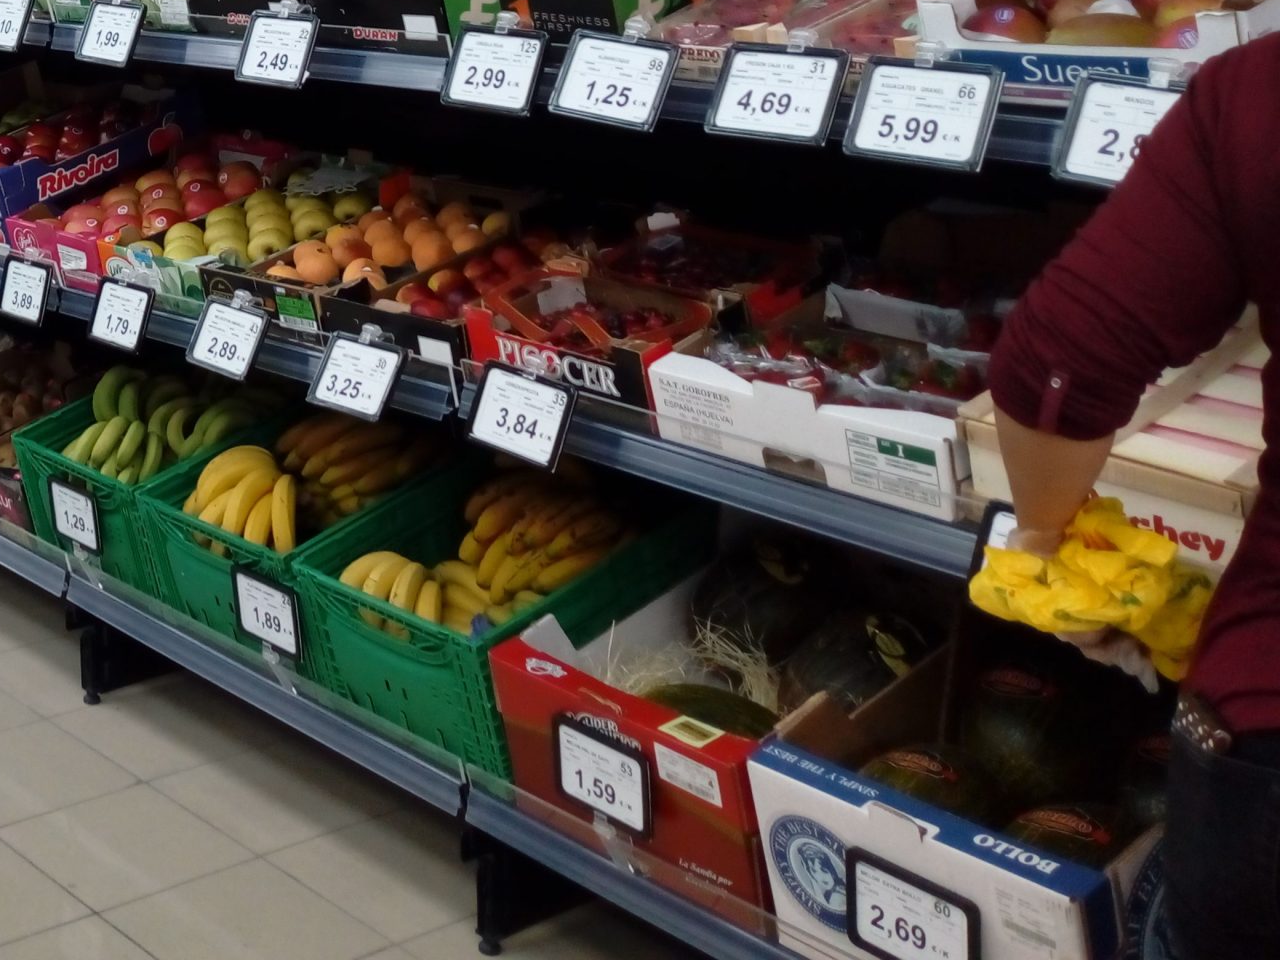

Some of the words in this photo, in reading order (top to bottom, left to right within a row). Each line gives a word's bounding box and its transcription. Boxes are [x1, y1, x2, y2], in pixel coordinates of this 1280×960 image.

[534, 11, 611, 27] FRESHNESS
[536, 21, 573, 33] FIRST
[96, 29, 120, 48] 1,99
[298, 29, 309, 40] 22
[520, 40, 538, 54] 125
[257, 50, 289, 72] 2,49
[648, 59, 664, 72] 98
[809, 61, 826, 74] 31
[464, 66, 506, 89] 2,99
[586, 80, 632, 108] 1,25
[737, 89, 793, 116] 4,69
[958, 86, 976, 100] 66
[878, 114, 939, 144] 5,99
[38, 149, 119, 201] Rivoira
[12, 292, 33, 309] 3,89
[106, 314, 129, 335] 1,79
[207, 337, 237, 361] 2,89
[326, 374, 362, 398] 3,25
[552, 393, 566, 407] 35
[496, 407, 538, 439] 3,84
[664, 399, 695, 413] ESPAÑA
[696, 408, 734, 426] (HUELVA)
[64, 510, 85, 532] 1,29
[253, 606, 281, 633] 1,89
[762, 745, 798, 763] BEST
[620, 763, 633, 777] 53
[797, 758, 825, 777] THE
[575, 769, 616, 805] 1,59
[825, 772, 879, 798] SIMPLY
[774, 828, 789, 853] THE
[787, 819, 821, 840] BEST
[972, 833, 1062, 875] BOLLO
[934, 900, 951, 918] 60
[870, 904, 926, 950] 2,69
